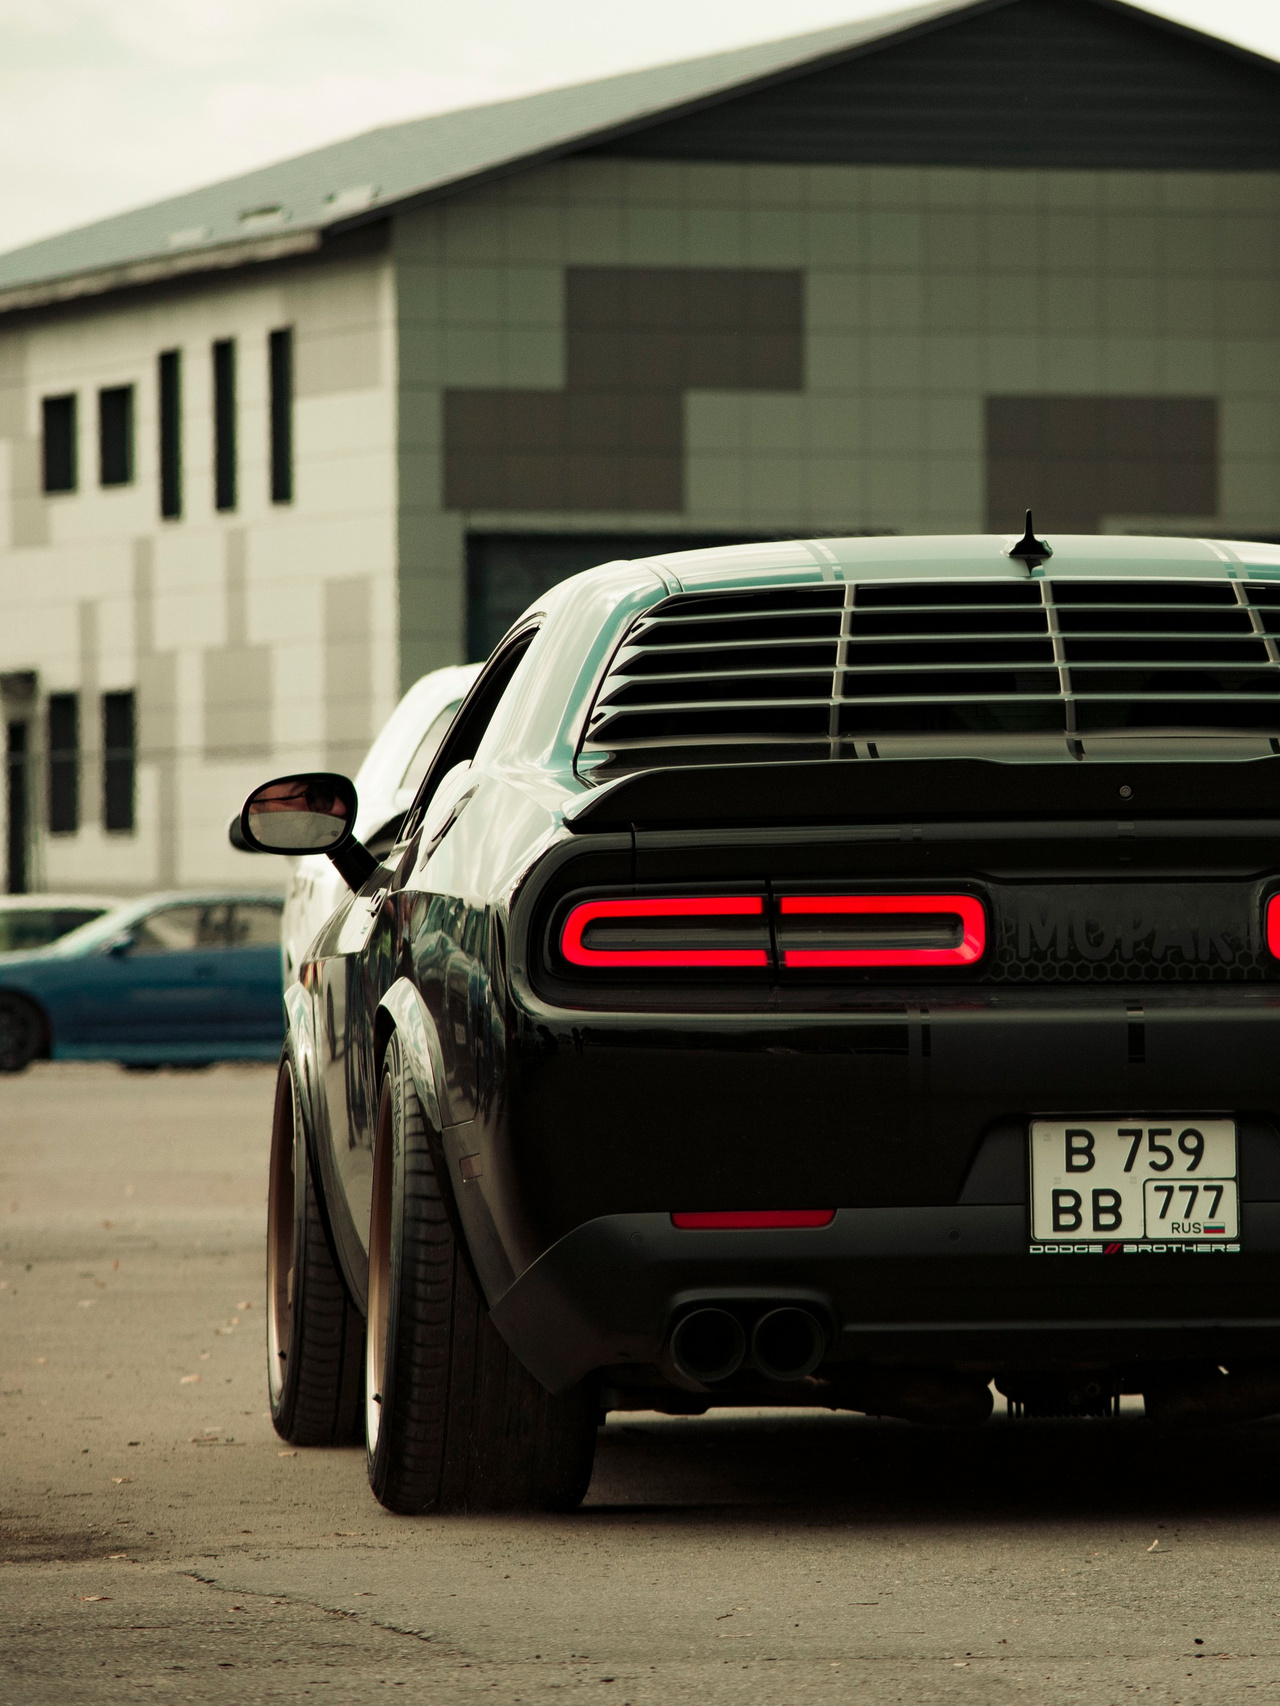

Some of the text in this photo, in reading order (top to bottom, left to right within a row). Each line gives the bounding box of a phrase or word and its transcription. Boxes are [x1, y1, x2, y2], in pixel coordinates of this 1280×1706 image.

[1017, 893, 1235, 962] MOPAR
[1065, 1128, 1205, 1173] B 759
[1052, 1185, 1224, 1232] BB 777
[1171, 1222, 1202, 1234] RUS
[1029, 1243, 1241, 1254] DODGE BROTHERS
